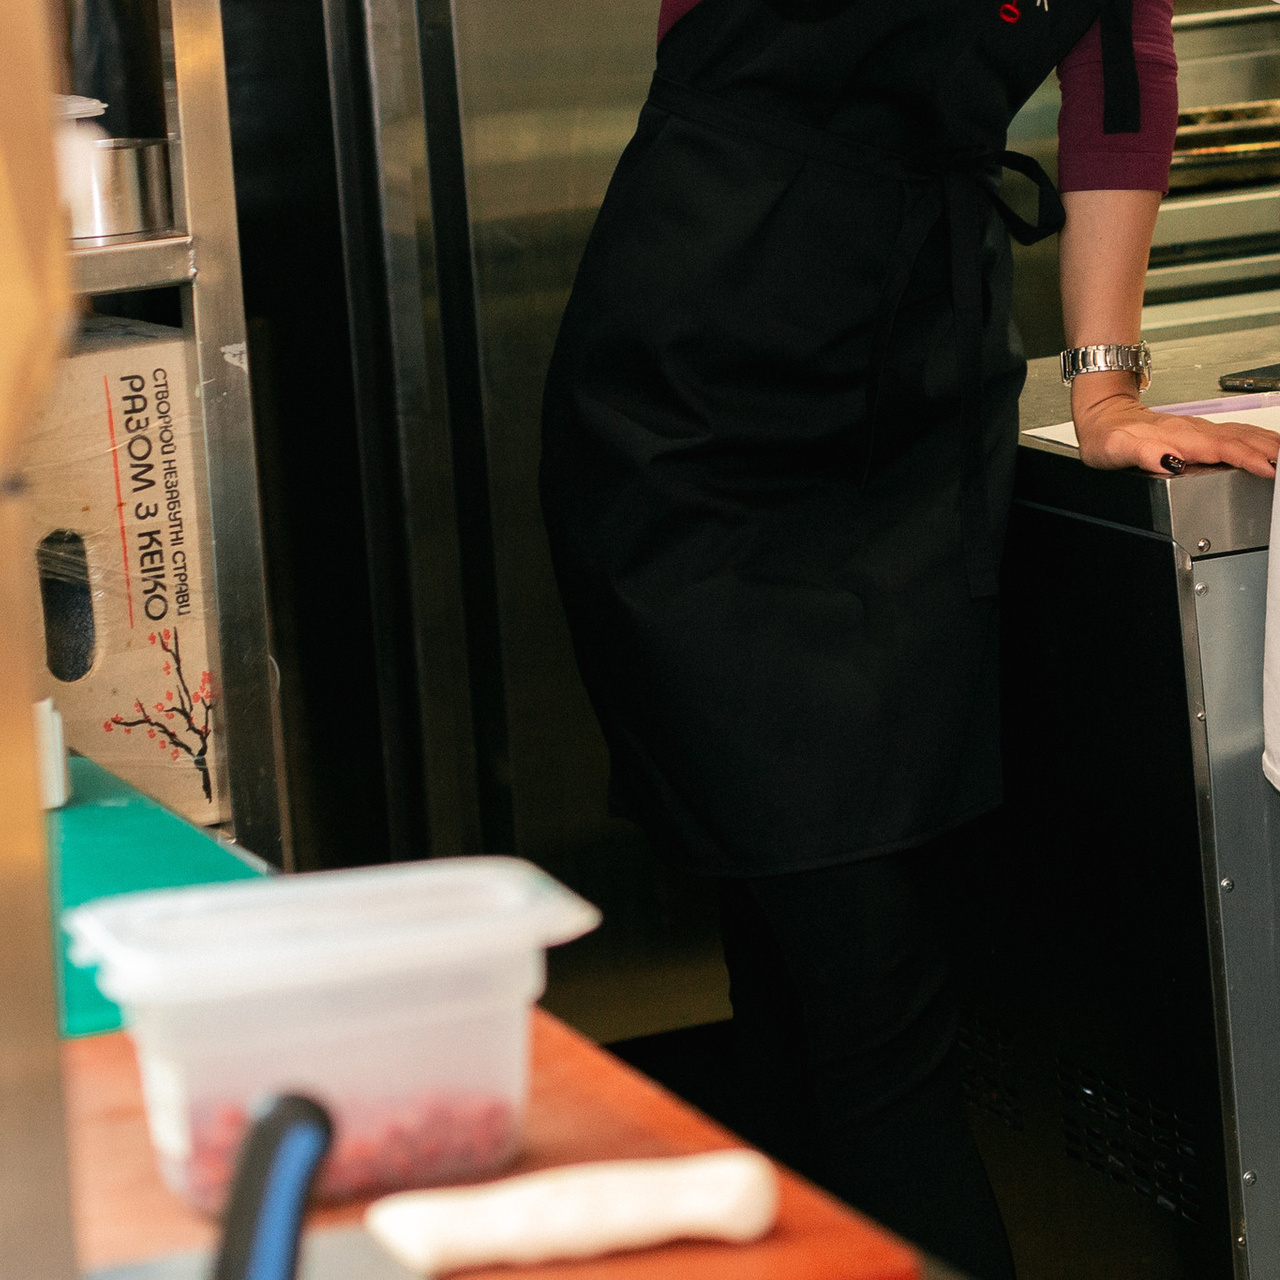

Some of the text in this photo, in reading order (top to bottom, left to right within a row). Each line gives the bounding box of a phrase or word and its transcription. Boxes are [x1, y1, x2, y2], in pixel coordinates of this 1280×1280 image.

[120, 374, 156, 494] РАЗОМ
[152, 367, 191, 616] СТВОРЮЙ НЕЗАБУТНІ СТРАВИ
